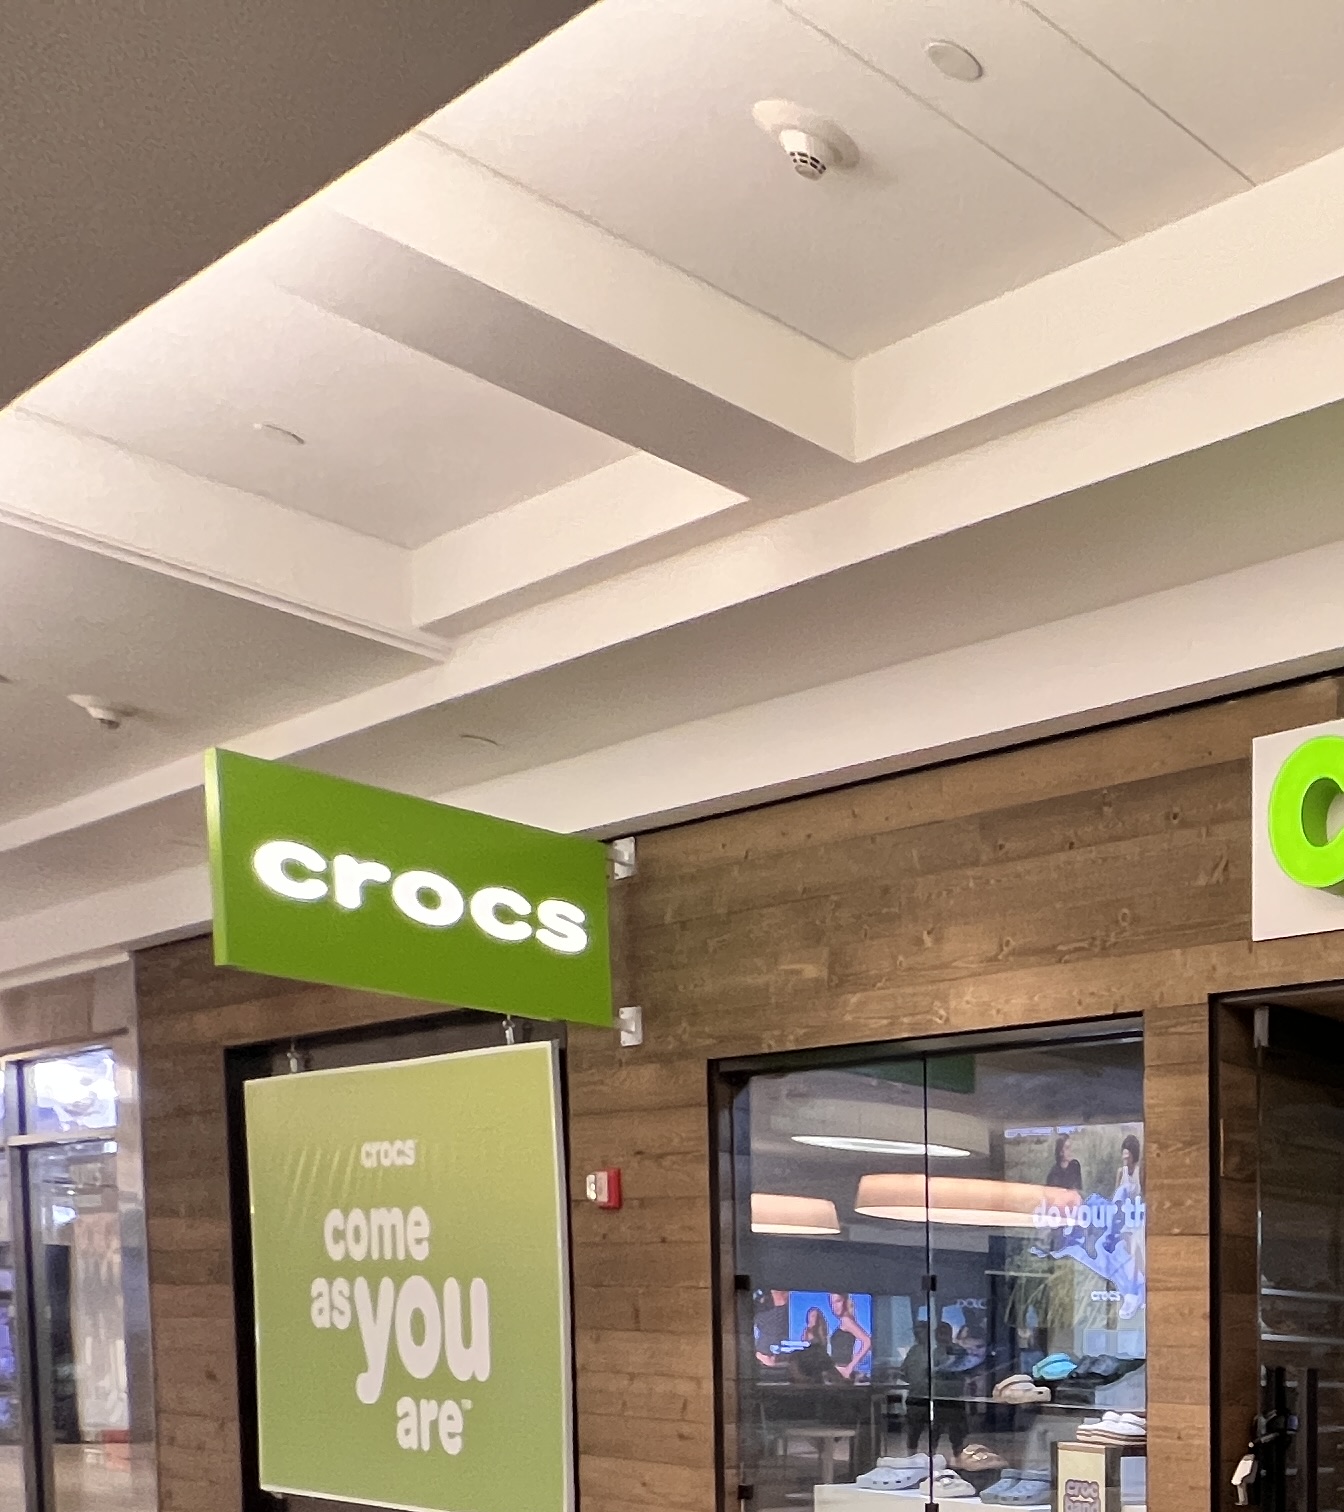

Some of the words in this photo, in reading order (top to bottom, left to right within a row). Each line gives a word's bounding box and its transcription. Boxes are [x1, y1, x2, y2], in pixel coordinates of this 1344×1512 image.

[252, 838, 590, 955] crocs
[360, 1139, 418, 1168] crocs
[324, 1206, 430, 1261] come
[1033, 1197, 1061, 1228] do
[1063, 1203, 1118, 1235] your
[1121, 1195, 1145, 1228] th
[310, 1276, 351, 1330] as
[354, 1274, 491, 1404] you
[396, 1396, 464, 1456] are
